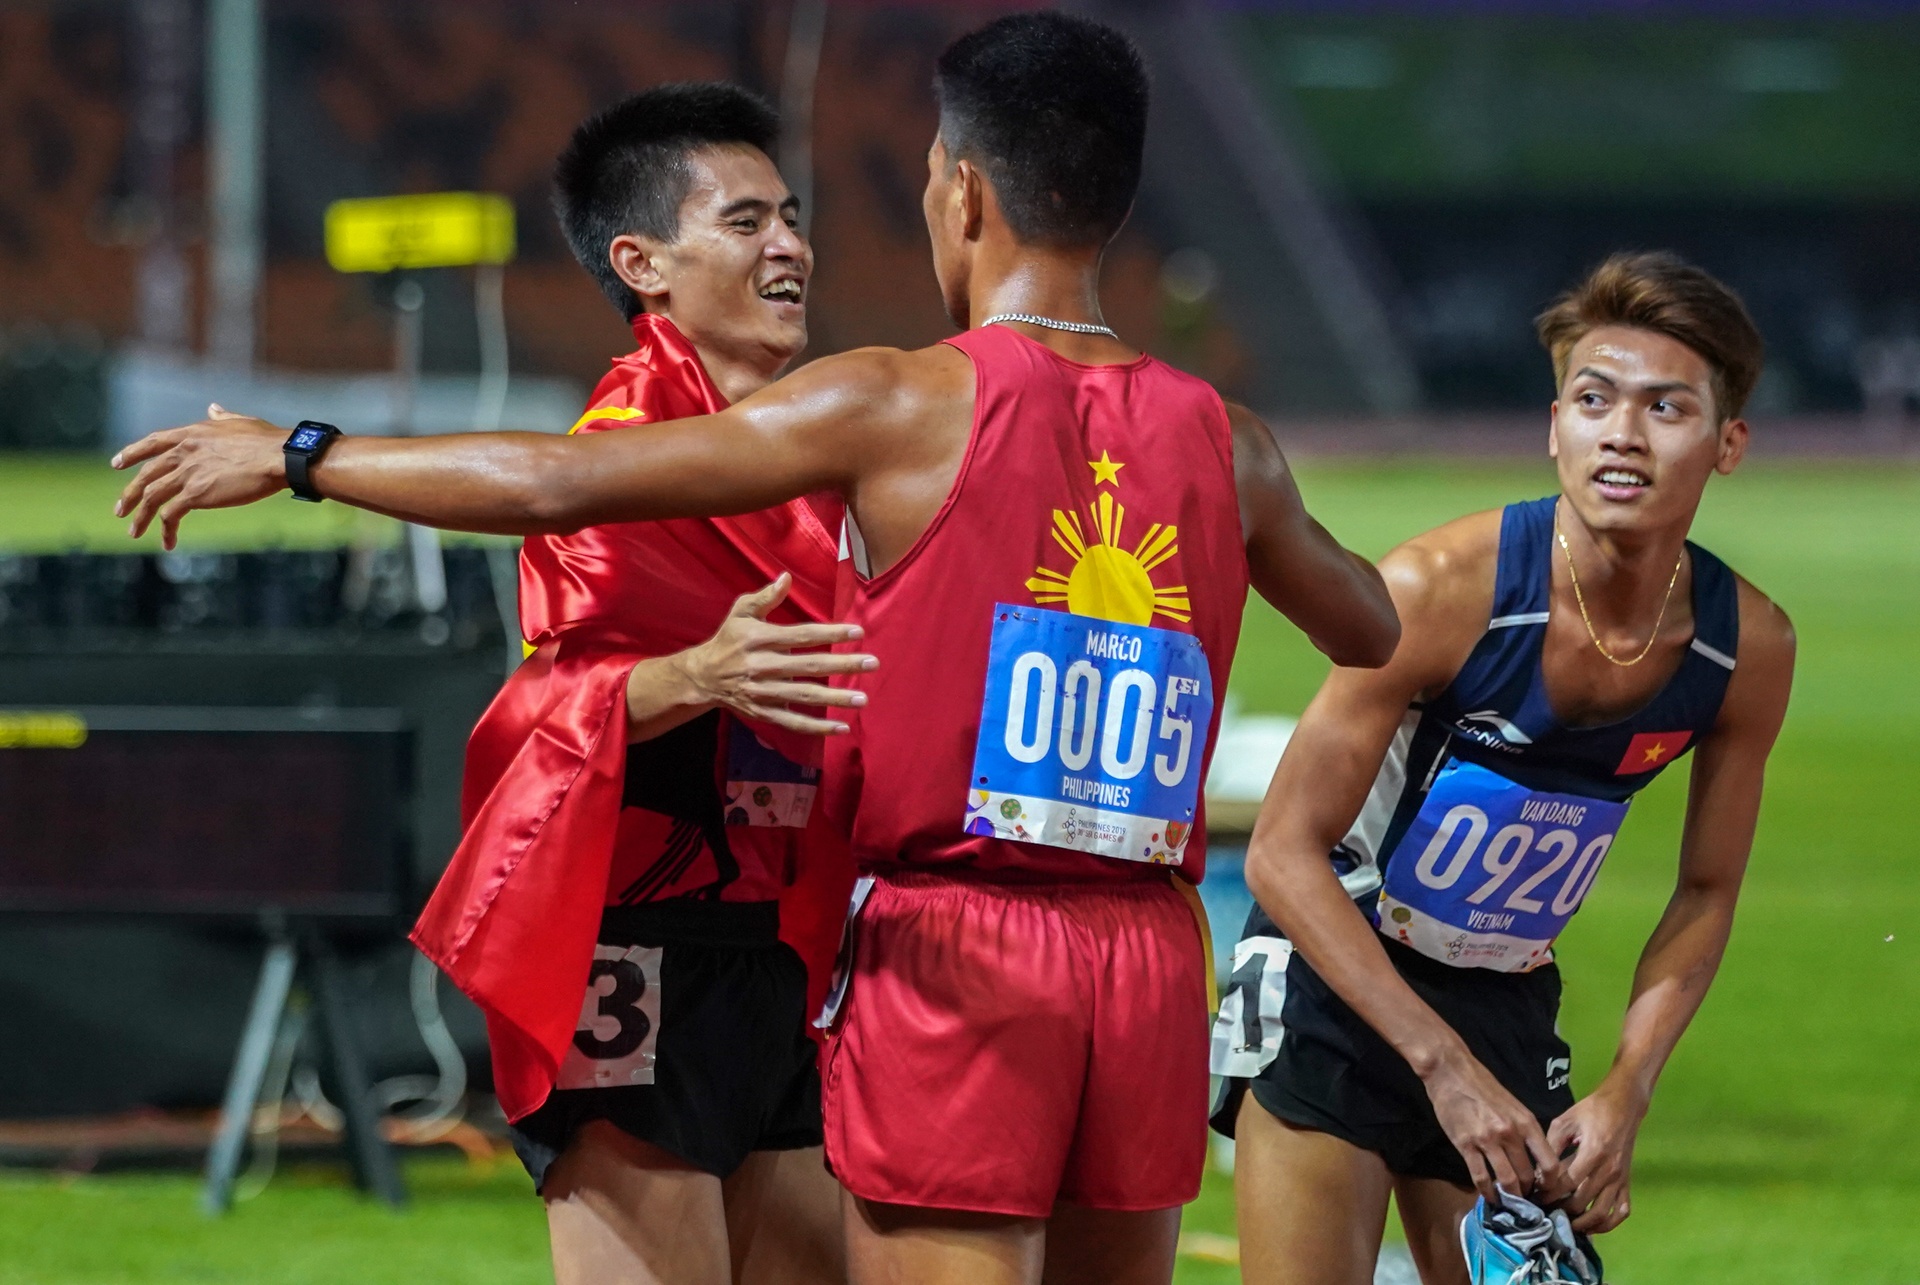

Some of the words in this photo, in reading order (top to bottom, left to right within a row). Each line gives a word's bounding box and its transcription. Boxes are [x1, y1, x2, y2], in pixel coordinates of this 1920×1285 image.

[1086, 629, 1142, 663] MARCO
[1004, 652, 1200, 788] 0005
[1062, 776, 1131, 808] PHILIPPINES
[1415, 804, 1613, 916] 0920
[1467, 909, 1516, 931] VIETNAM
[572, 959, 651, 1060] 3
